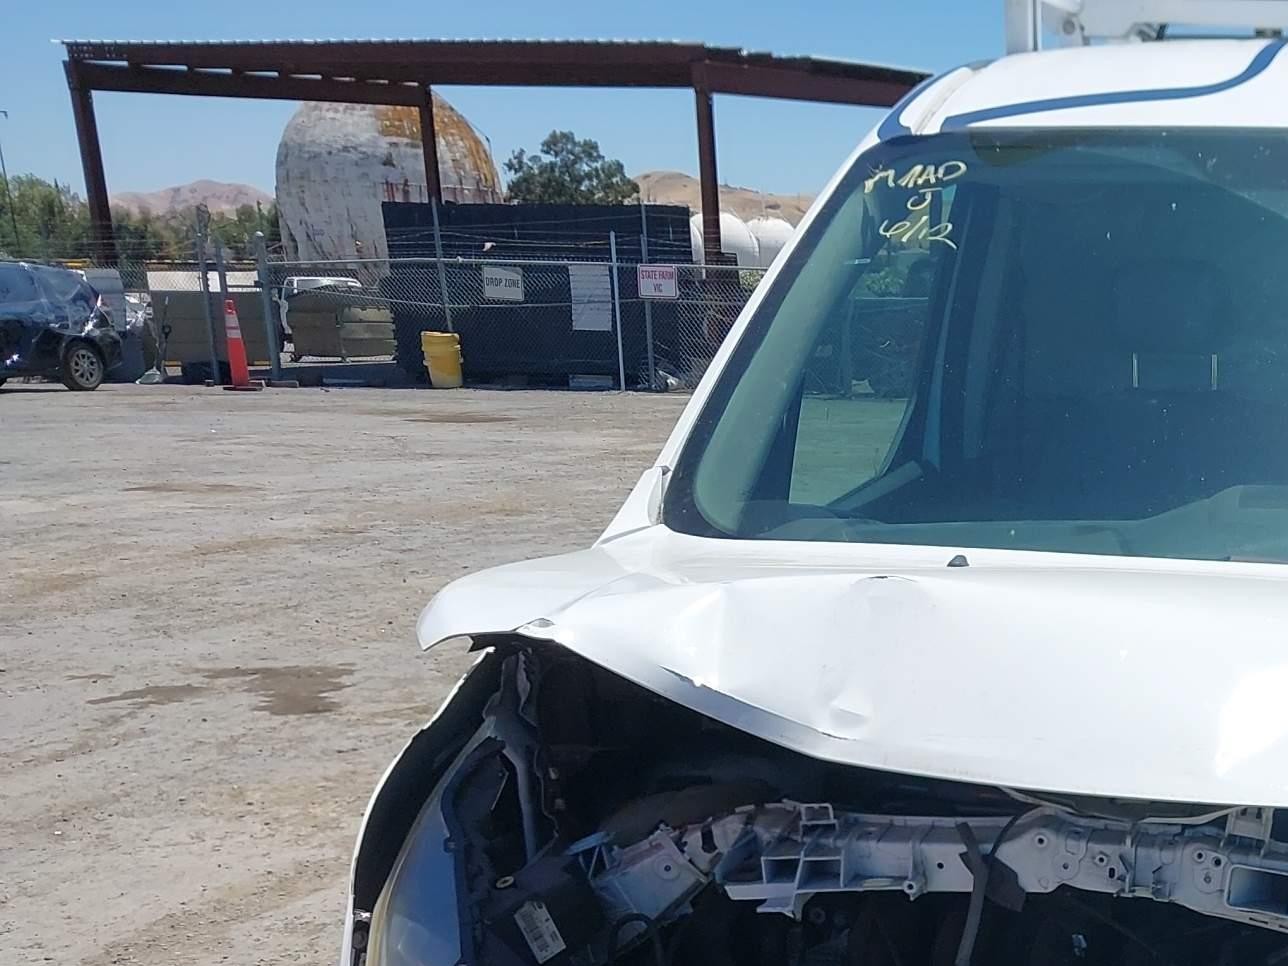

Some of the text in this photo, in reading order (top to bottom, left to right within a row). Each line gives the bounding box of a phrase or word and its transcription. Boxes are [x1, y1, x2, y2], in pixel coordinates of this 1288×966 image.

[640, 270, 674, 280] STATE FARM
[485, 276, 521, 289] DROP ZONE
